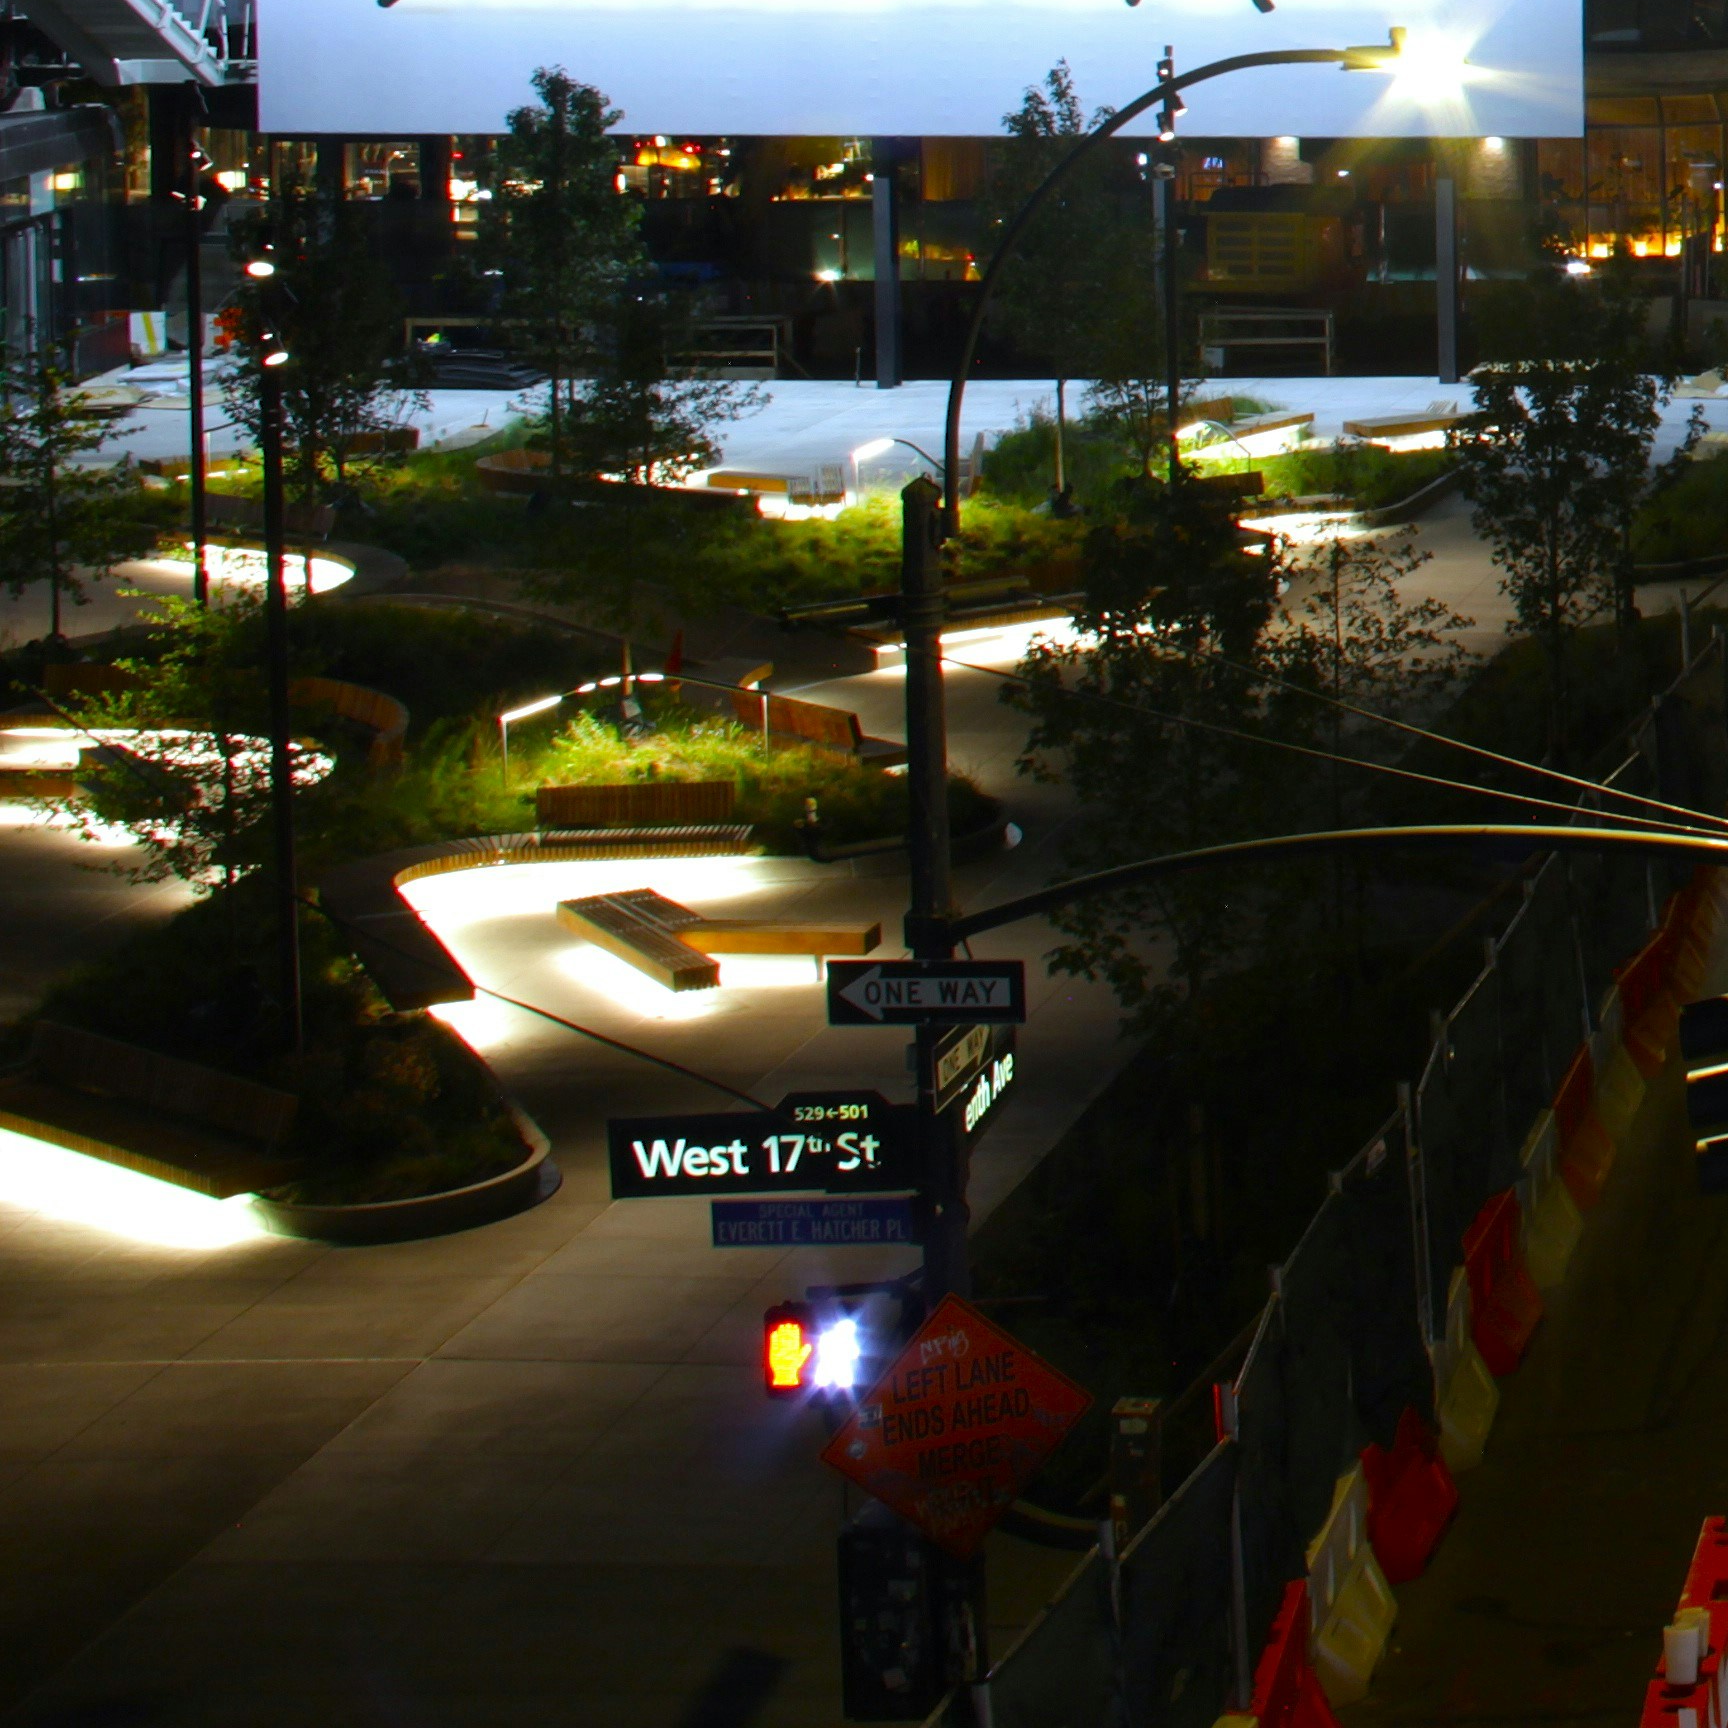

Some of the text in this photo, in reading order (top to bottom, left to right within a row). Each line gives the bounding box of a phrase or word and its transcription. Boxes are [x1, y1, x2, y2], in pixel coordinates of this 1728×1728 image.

[864, 980, 997, 1005] ONE WAY
[794, 1104, 869, 1121] 529 501
[958, 1052, 1015, 1133] enth Ave
[632, 1137, 750, 1179] West
[837, 1131, 881, 1172] St
[716, 1220, 906, 1243] EVERETT E HATCHER PL
[758, 1202, 864, 1219] SPECIAL AGENT
[892, 1351, 1015, 1403] LEFT LANE
[882, 1387, 1030, 1446] ENDS AHEAD
[917, 1435, 1002, 1480] MERGE
